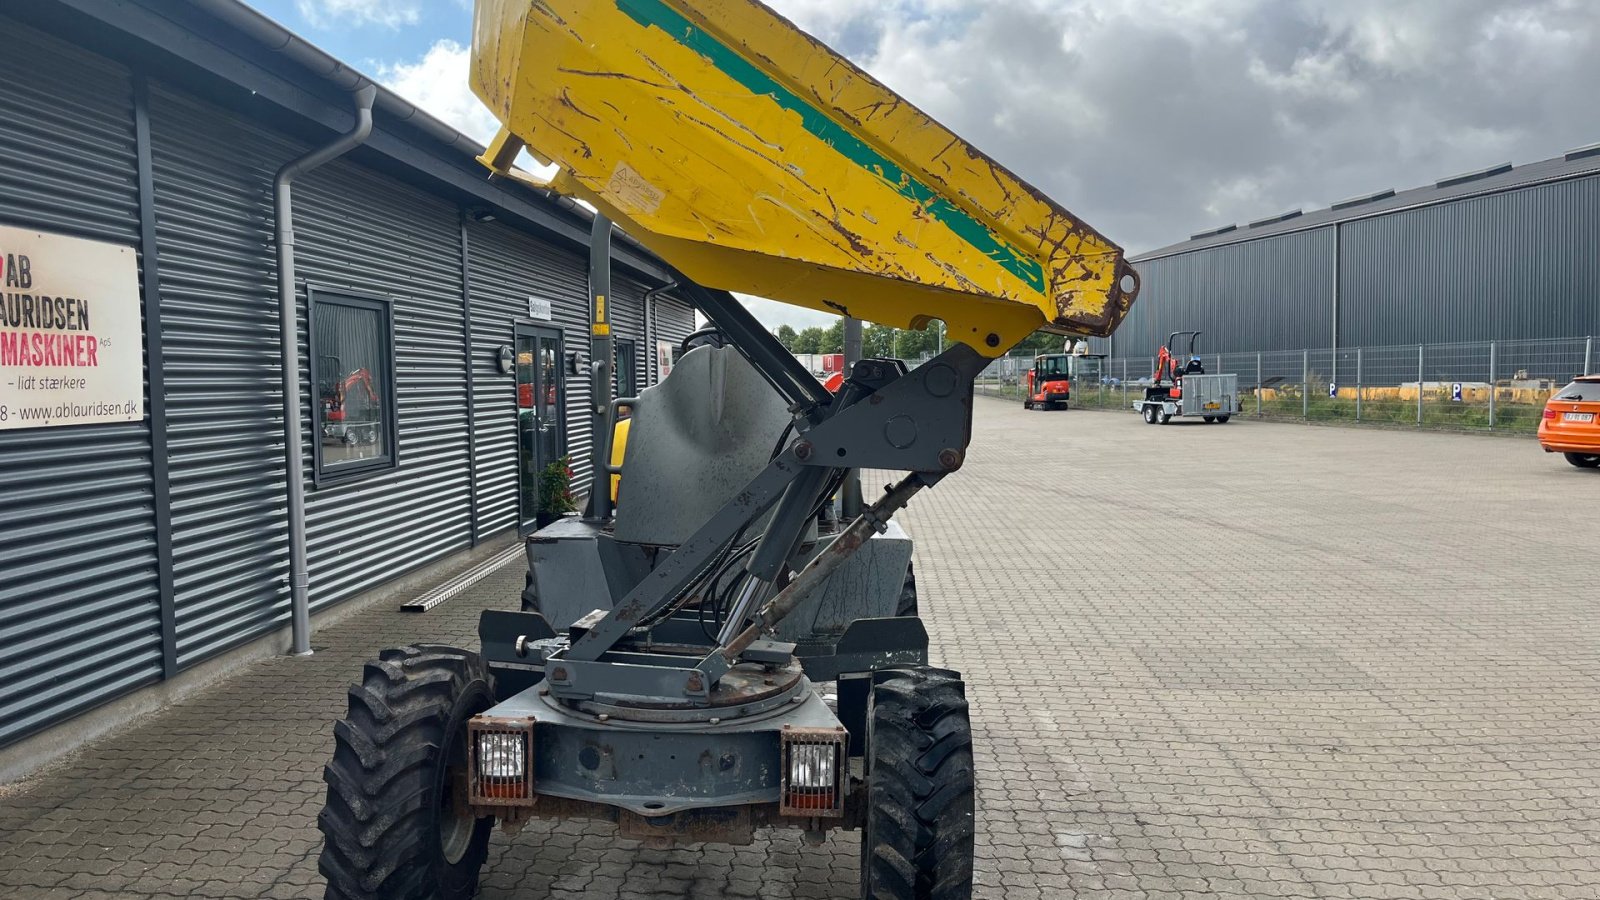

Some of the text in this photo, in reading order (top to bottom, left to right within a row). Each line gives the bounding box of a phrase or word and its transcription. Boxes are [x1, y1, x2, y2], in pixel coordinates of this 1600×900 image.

[6, 253, 32, 289] AB
[1, 331, 112, 367] MASKINER ApS
[18, 375, 36, 390] lidt
[39, 375, 86, 390] stærkere
[1330, 383, 1335, 395] P
[1453, 384, 1460, 397] P
[19, 400, 137, 420] www.ablauridsen.dk
